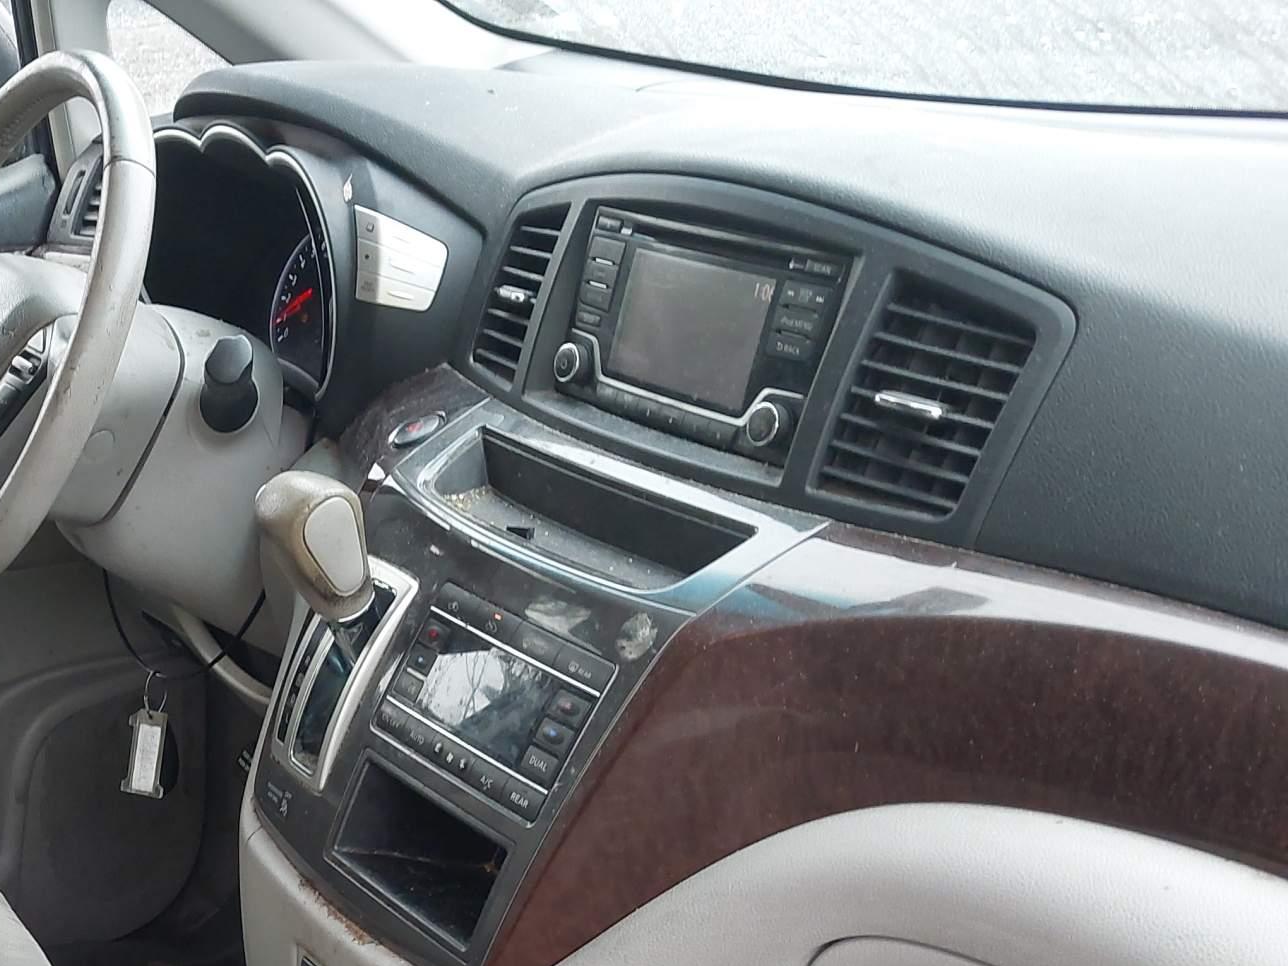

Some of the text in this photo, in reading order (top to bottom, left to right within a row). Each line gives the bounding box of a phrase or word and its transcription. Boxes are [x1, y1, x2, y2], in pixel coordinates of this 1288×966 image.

[528, 754, 548, 773] DUAL
[479, 775, 493, 789] A/C
[510, 791, 529, 809] REAR
